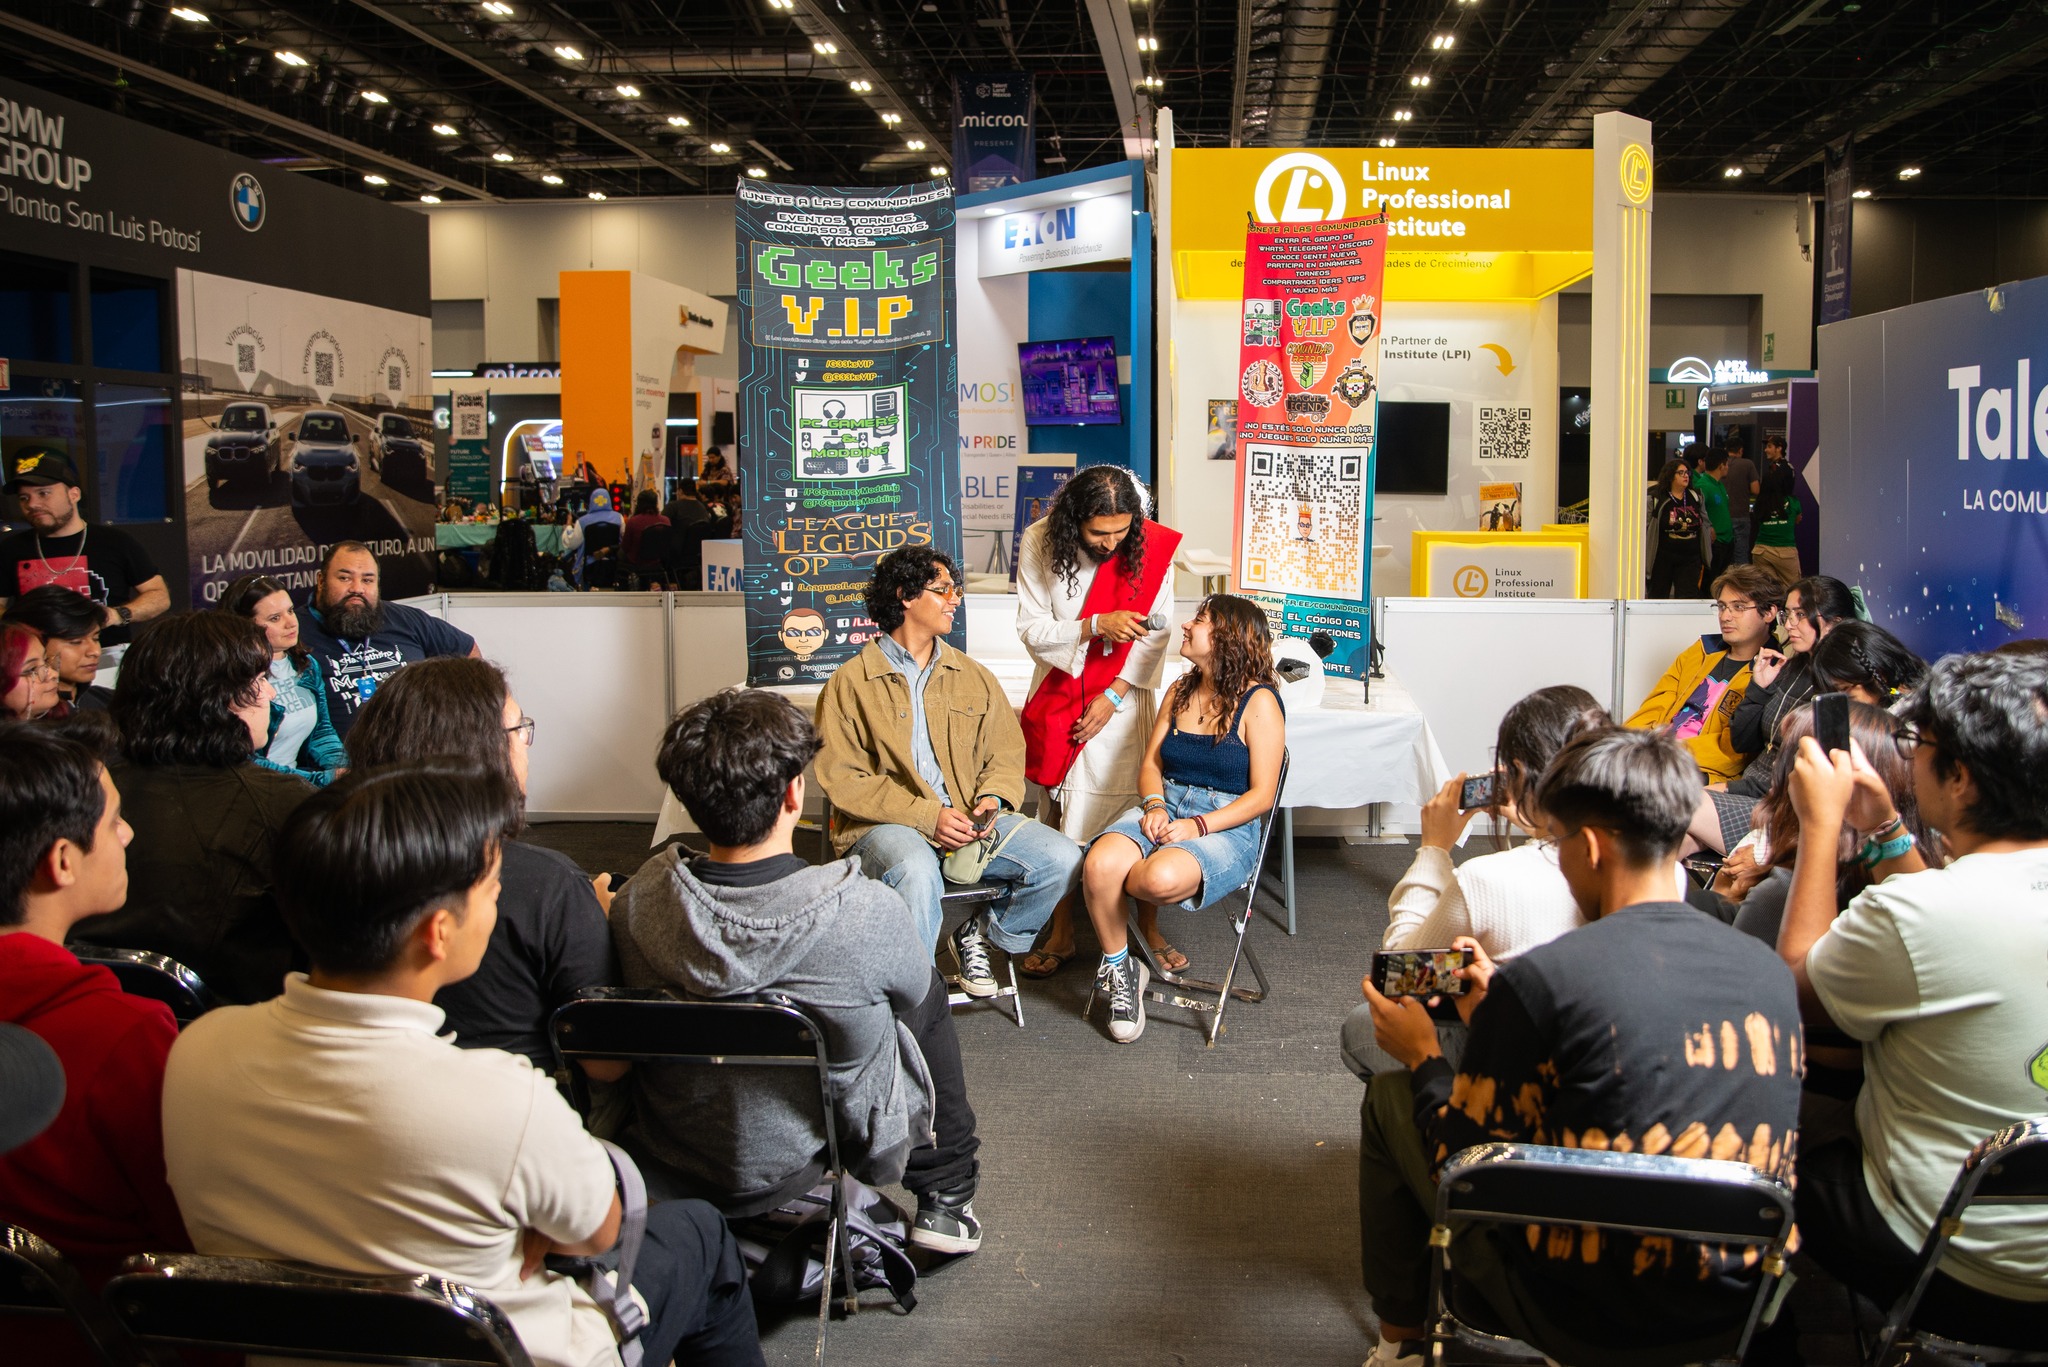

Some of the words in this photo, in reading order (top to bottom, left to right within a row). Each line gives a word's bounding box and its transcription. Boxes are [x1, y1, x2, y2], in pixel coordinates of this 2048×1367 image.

[959, 111, 1029, 127] micron
[1362, 160, 1430, 181] Linux
[797, 198, 809, 207] A
[812, 198, 844, 209] LAS
[847, 187, 950, 210] COMUNIDADES!
[1362, 188, 1511, 209] Professional
[66, 201, 105, 233] San
[109, 211, 146, 242] Luis
[149, 219, 202, 253] Potosí
[1004, 207, 1076, 249] EATON
[1283, 226, 1291, 234] A
[1294, 226, 1312, 234] LAS
[1387, 216, 1467, 236] stitute
[821, 237, 833, 246] Y
[1314, 235, 1340, 243] GRUPO
[1342, 233, 1354, 241] DE
[1339, 239, 1374, 250] DISCORD
[1019, 251, 1045, 263] Powering
[1045, 247, 1071, 260] Business
[1071, 243, 1103, 256] Worldwide
[1271, 253, 1300, 261] CONOCE
[757, 246, 938, 290] Geeks
[1414, 259, 1427, 268] de
[1430, 259, 1493, 268] Crecimiento
[1296, 269, 1330, 277] TORNEOS
[1347, 275, 1366, 283] TIPS
[1321, 285, 1338, 293] MÁS
[1286, 299, 1346, 317] Geeks
[781, 295, 913, 337] V.I.P
[226, 323, 266, 352] Vinculación
[1391, 336, 1431, 345] Partner
[1435, 336, 1448, 345] de
[303, 330, 321, 375] Programa
[1384, 350, 1438, 359] Institute
[1442, 350, 1471, 361] (LPI)
[1714, 360, 1748, 371] APEX
[960, 382, 1015, 402] MOS!
[1286, 401, 1331, 413] LEGENDS
[800, 418, 823, 429] PC
[828, 414, 900, 429] GAMERS
[1262, 423, 1291, 432] ESTÉS
[1292, 425, 1312, 433] SOLO
[1315, 425, 1346, 433] NUNCA
[1349, 424, 1371, 433] MÁS!
[841, 434, 859, 443] &
[974, 436, 1016, 448] PRIDE
[1257, 432, 1293, 441] JUEGUES
[1295, 435, 1316, 443] SOLO
[1320, 435, 1352, 443] NUNCA
[811, 446, 890, 458] MODDING
[961, 476, 1009, 498] BLE
[1963, 489, 1985, 511] LA
[786, 512, 903, 531] LEAGUE
[777, 522, 932, 554] LEGENDS
[202, 554, 226, 574] LA
[229, 545, 317, 572] MOVILIDAD
[407, 537, 417, 552] A
[418, 536, 436, 553] UN
[784, 557, 829, 576] OP
[1495, 568, 1522, 576] Linux
[708, 564, 744, 591] EATON
[1495, 578, 1554, 587] Professional
[1495, 589, 1536, 598] Institute
[1287, 612, 1302, 621] EL
[1306, 614, 1342, 625] CÓDIGO
[1269, 621, 1288, 630] QUE
[1323, 662, 1354, 674] NIRTE.
